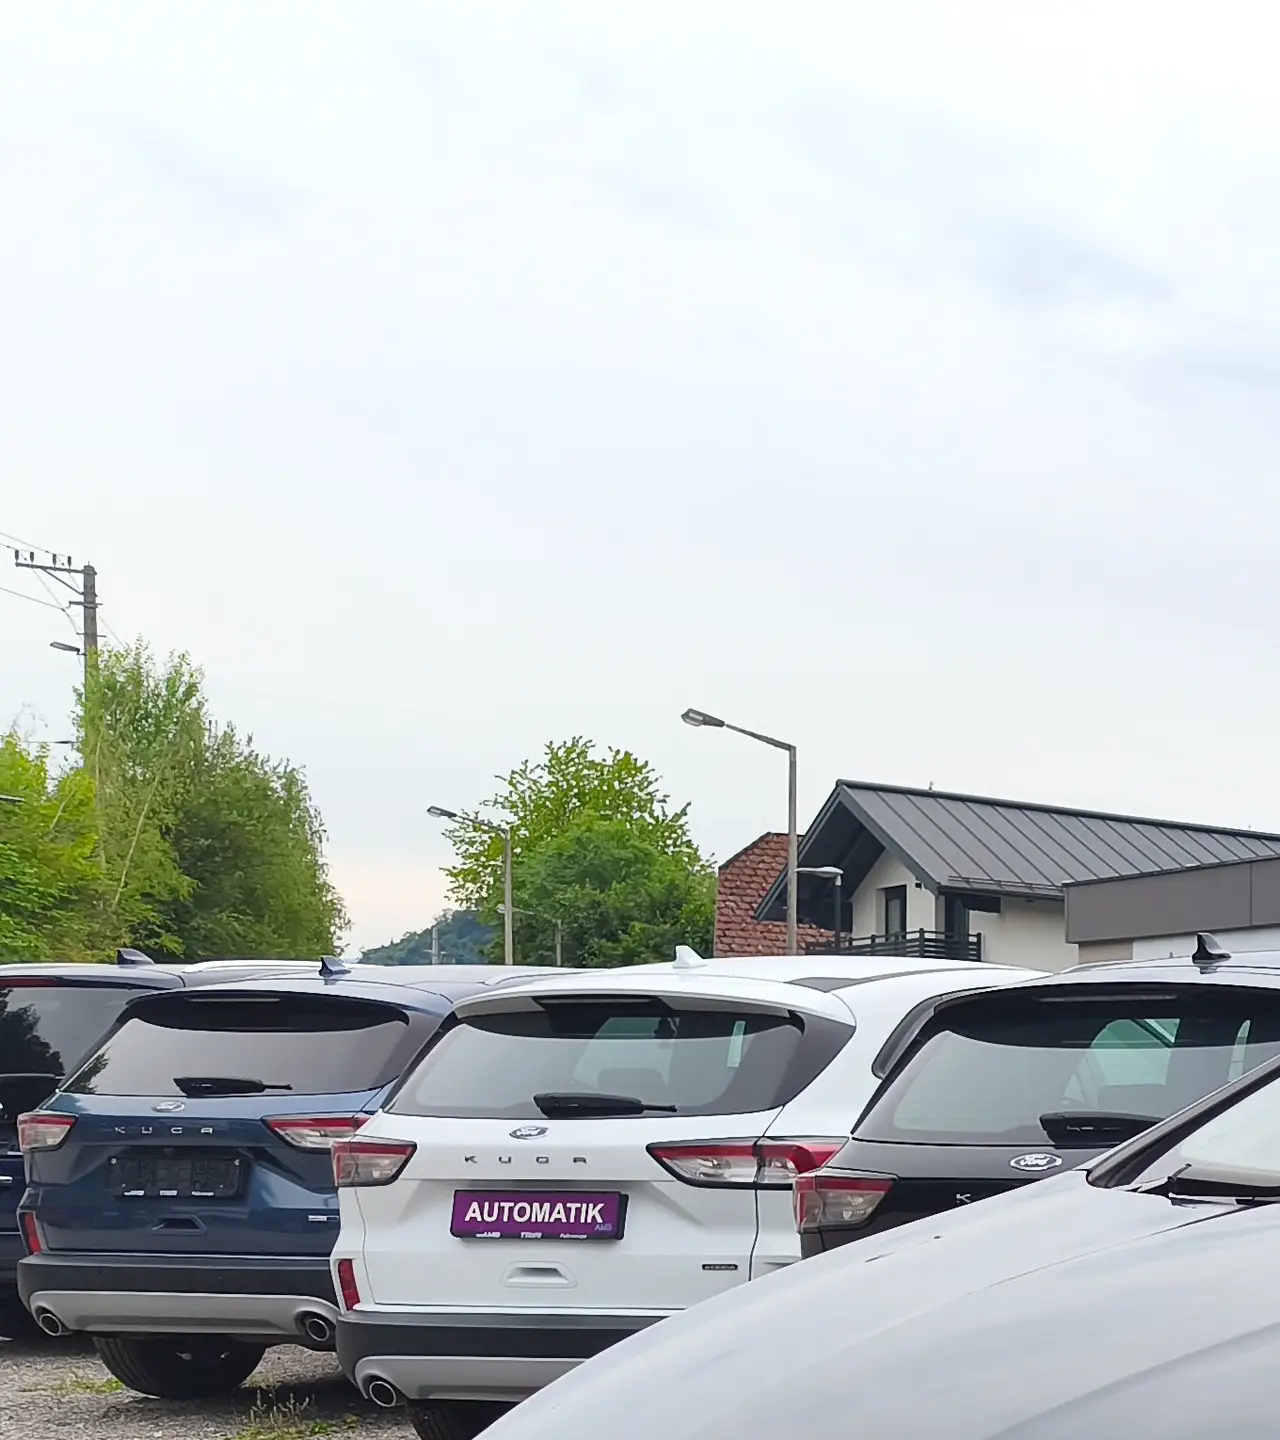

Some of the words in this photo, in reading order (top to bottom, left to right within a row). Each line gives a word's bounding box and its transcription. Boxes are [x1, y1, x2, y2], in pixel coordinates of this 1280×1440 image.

[114, 1126, 214, 1135] KUGA
[464, 1155, 588, 1164] KUGA
[464, 1201, 606, 1223] AUTOMATIK
